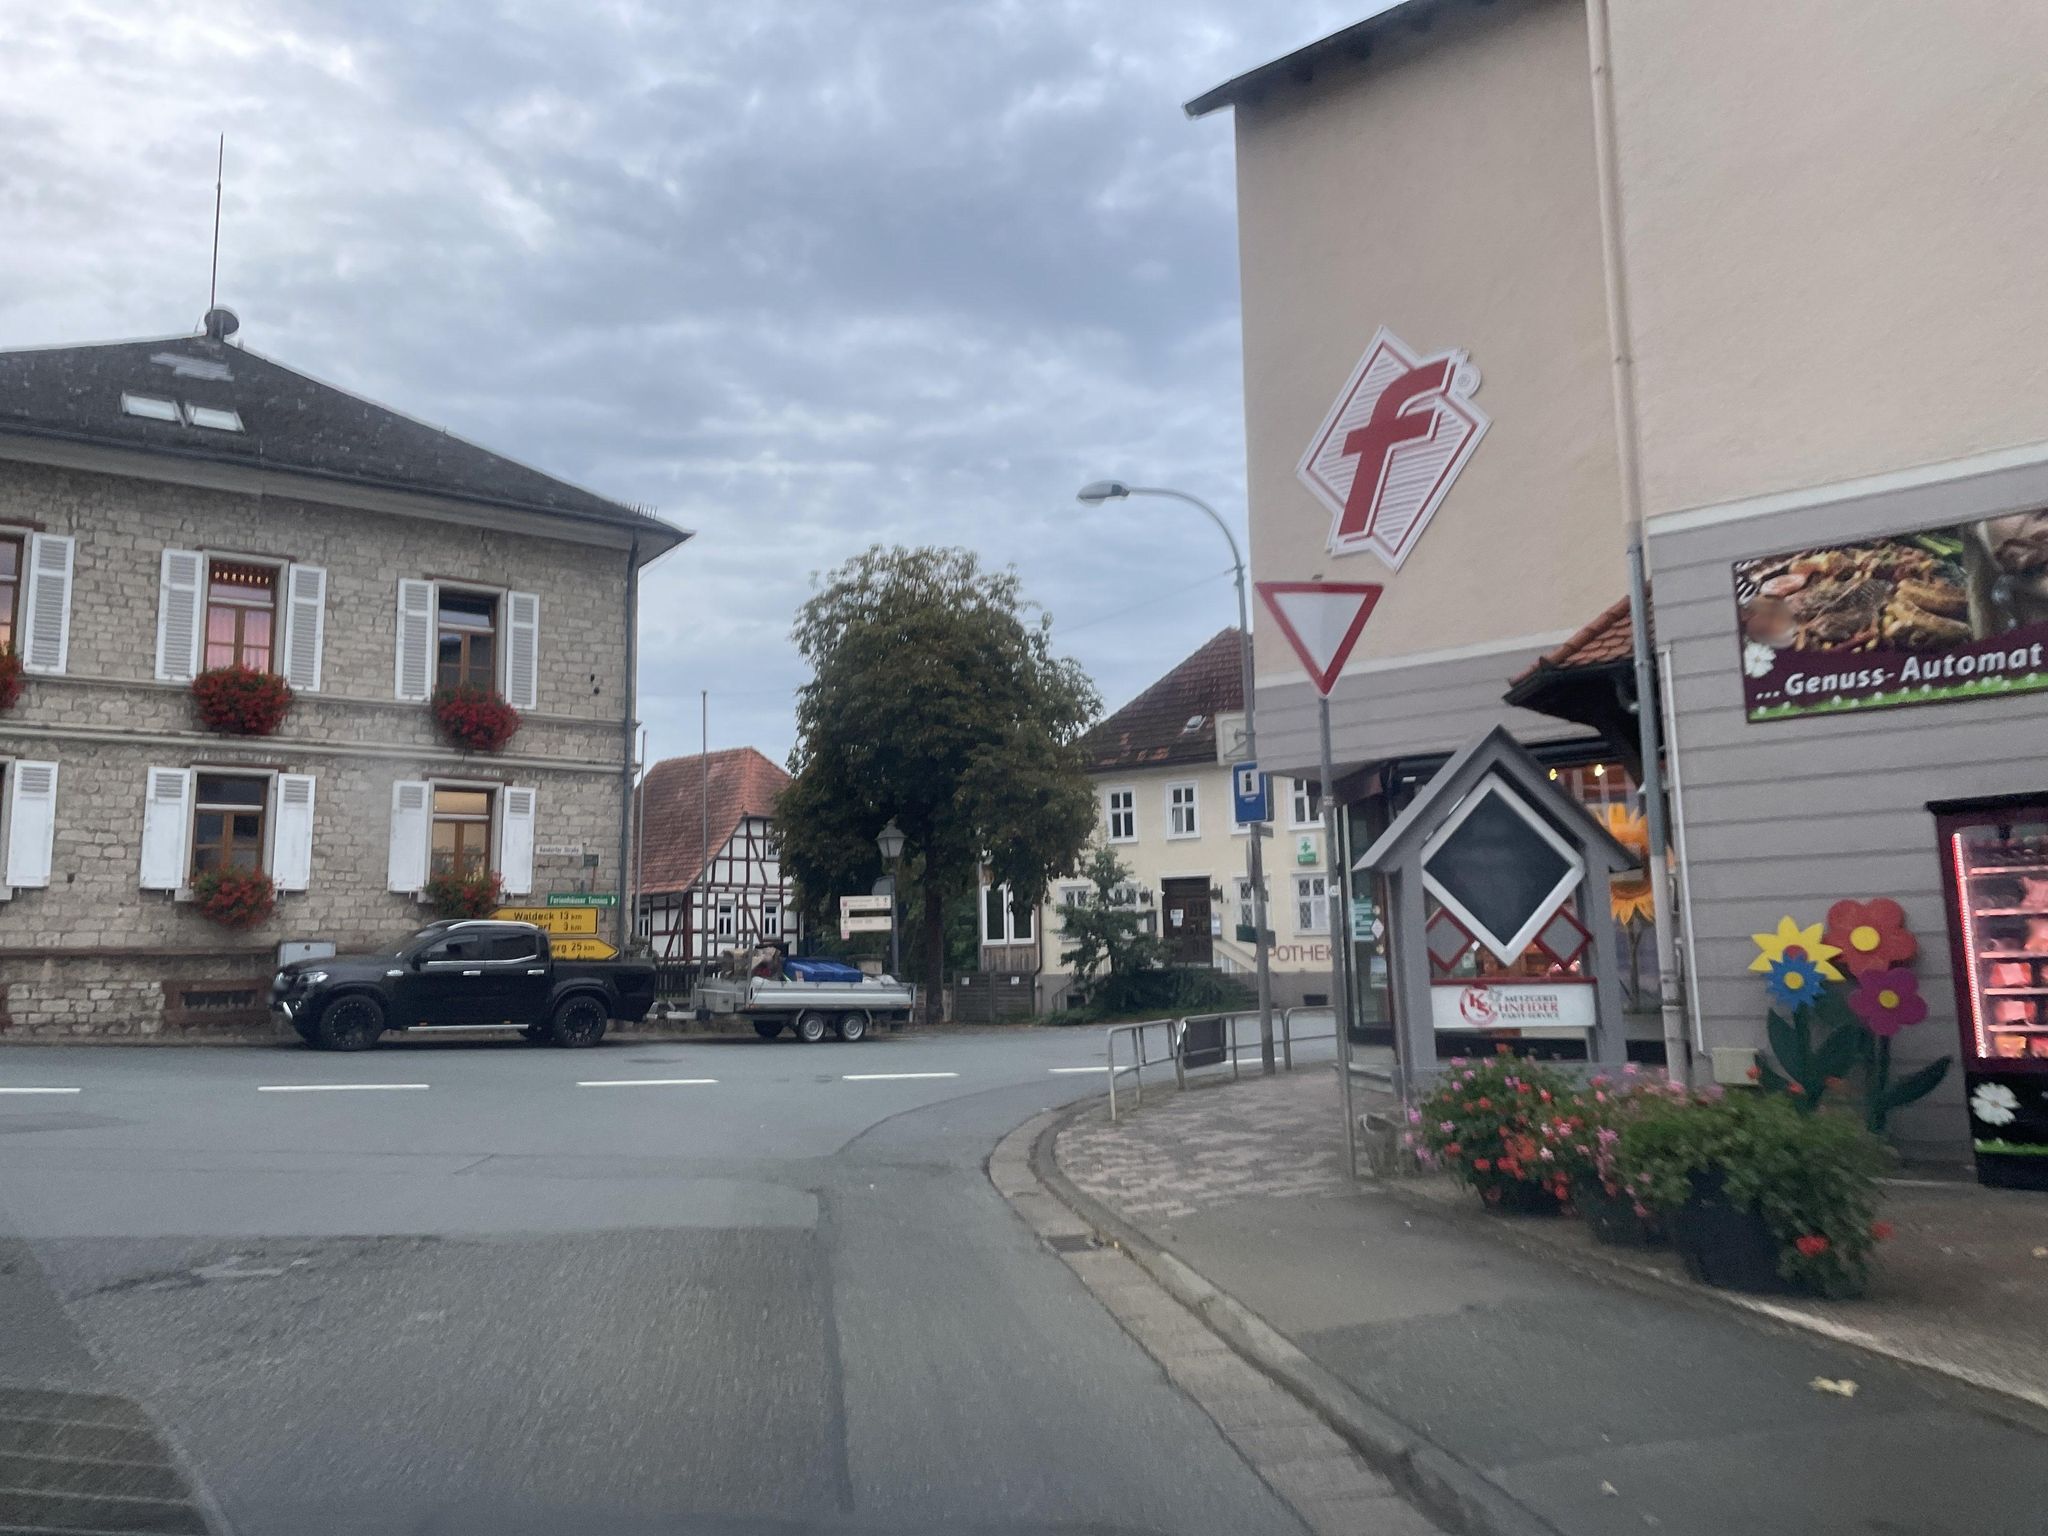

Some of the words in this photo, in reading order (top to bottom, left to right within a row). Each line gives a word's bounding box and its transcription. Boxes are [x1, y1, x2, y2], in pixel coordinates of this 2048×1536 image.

[1900, 642, 2043, 682] Automat
[514, 910, 554, 921] Waldeck
[559, 910, 569, 920] 13
[563, 923, 569, 931] 3
[570, 923, 582, 931] km
[571, 943, 582, 952] 25
